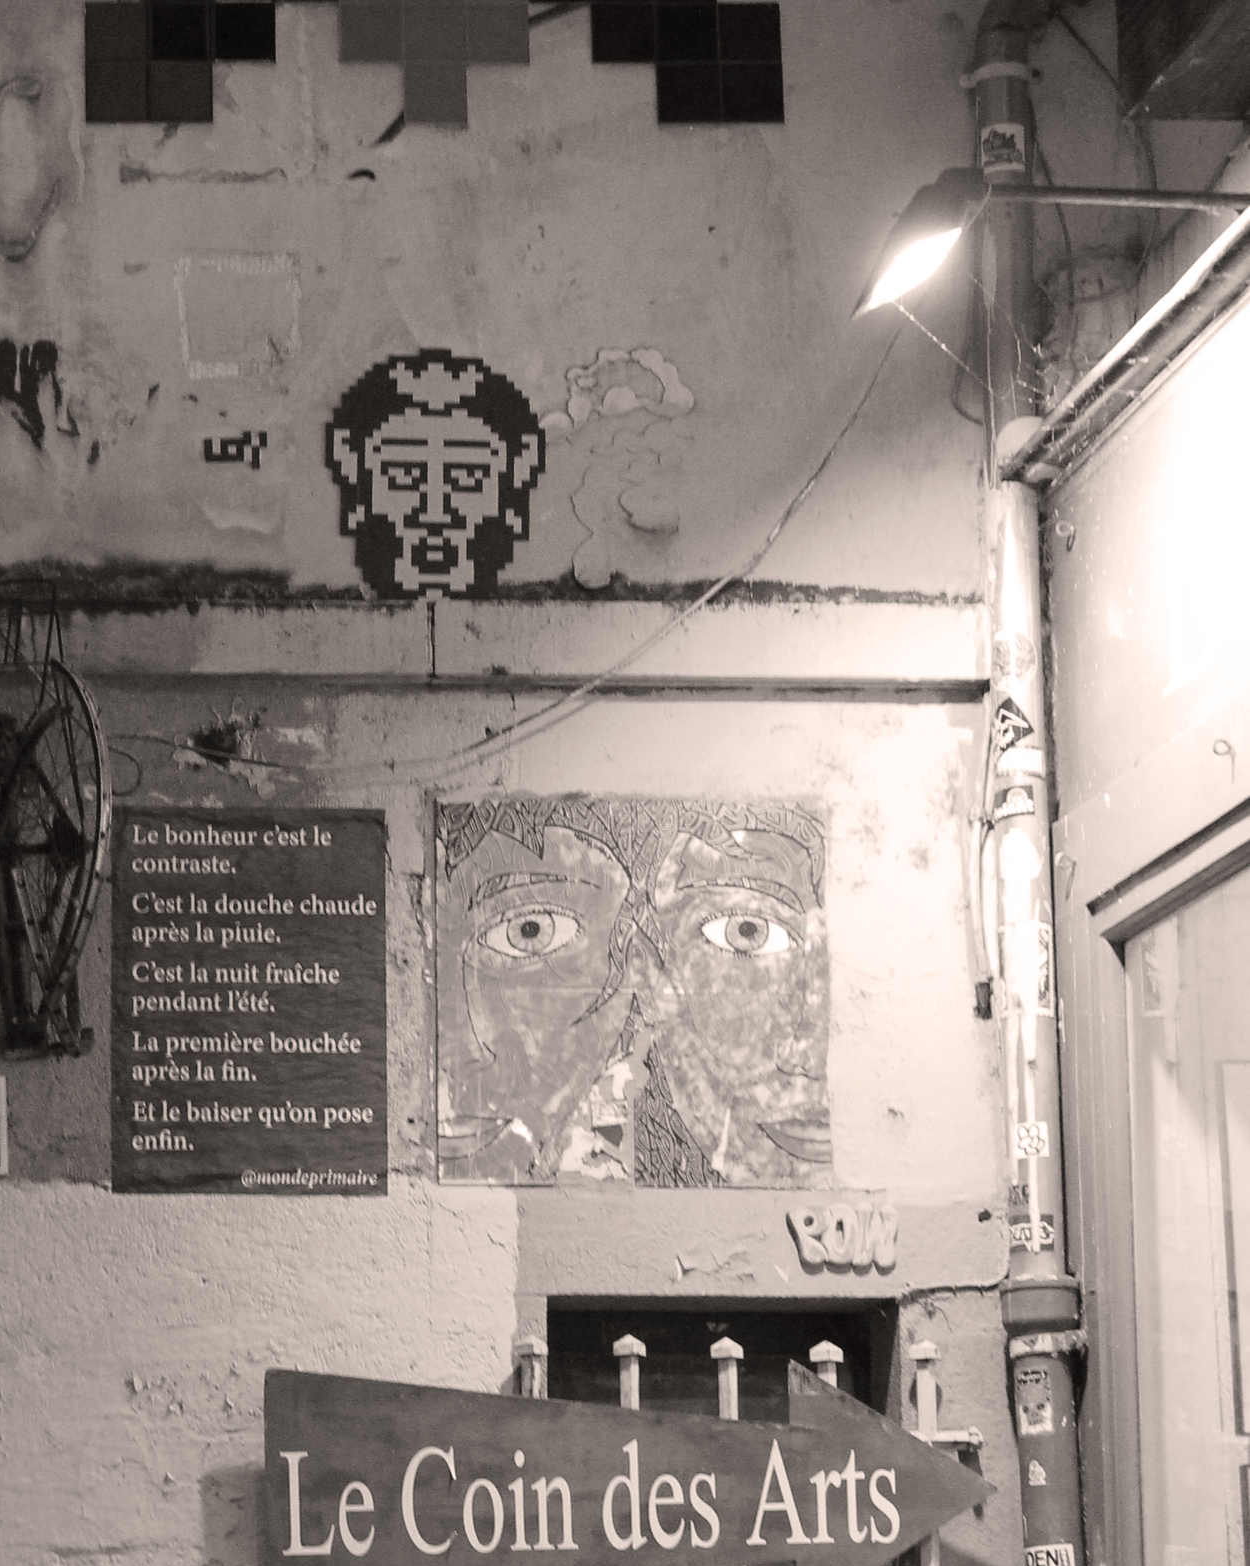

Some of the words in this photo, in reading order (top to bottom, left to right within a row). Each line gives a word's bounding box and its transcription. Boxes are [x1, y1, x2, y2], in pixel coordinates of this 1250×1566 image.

[133, 824, 159, 845] Le
[165, 823, 258, 846] bonheur
[313, 825, 332, 846] le
[132, 855, 237, 875] contraste.
[190, 892, 209, 914] la
[214, 893, 294, 915] douche
[299, 893, 377, 916] chaude
[132, 921, 190, 948] après
[196, 921, 215, 943] la
[221, 921, 281, 949] pluie.
[190, 961, 209, 983] la
[215, 962, 259, 983] nuit
[266, 961, 340, 985] fraîche
[132, 991, 221, 1016] pendant
[132, 1031, 159, 1052] La
[166, 1030, 264, 1058] première
[270, 1031, 362, 1054] bouchée
[132, 1059, 190, 1086] après
[196, 1060, 215, 1081] la
[222, 1059, 257, 1082] fin.
[133, 1101, 155, 1122] Et
[162, 1100, 181, 1122] le
[187, 1100, 253, 1123] baiser
[323, 1107, 374, 1129] pose
[131, 1128, 194, 1151] enfin.
[279, 1451, 376, 1557] Le
[401, 1445, 579, 1555] Coin
[602, 1438, 720, 1551] des
[745, 1438, 901, 1546] Arts
